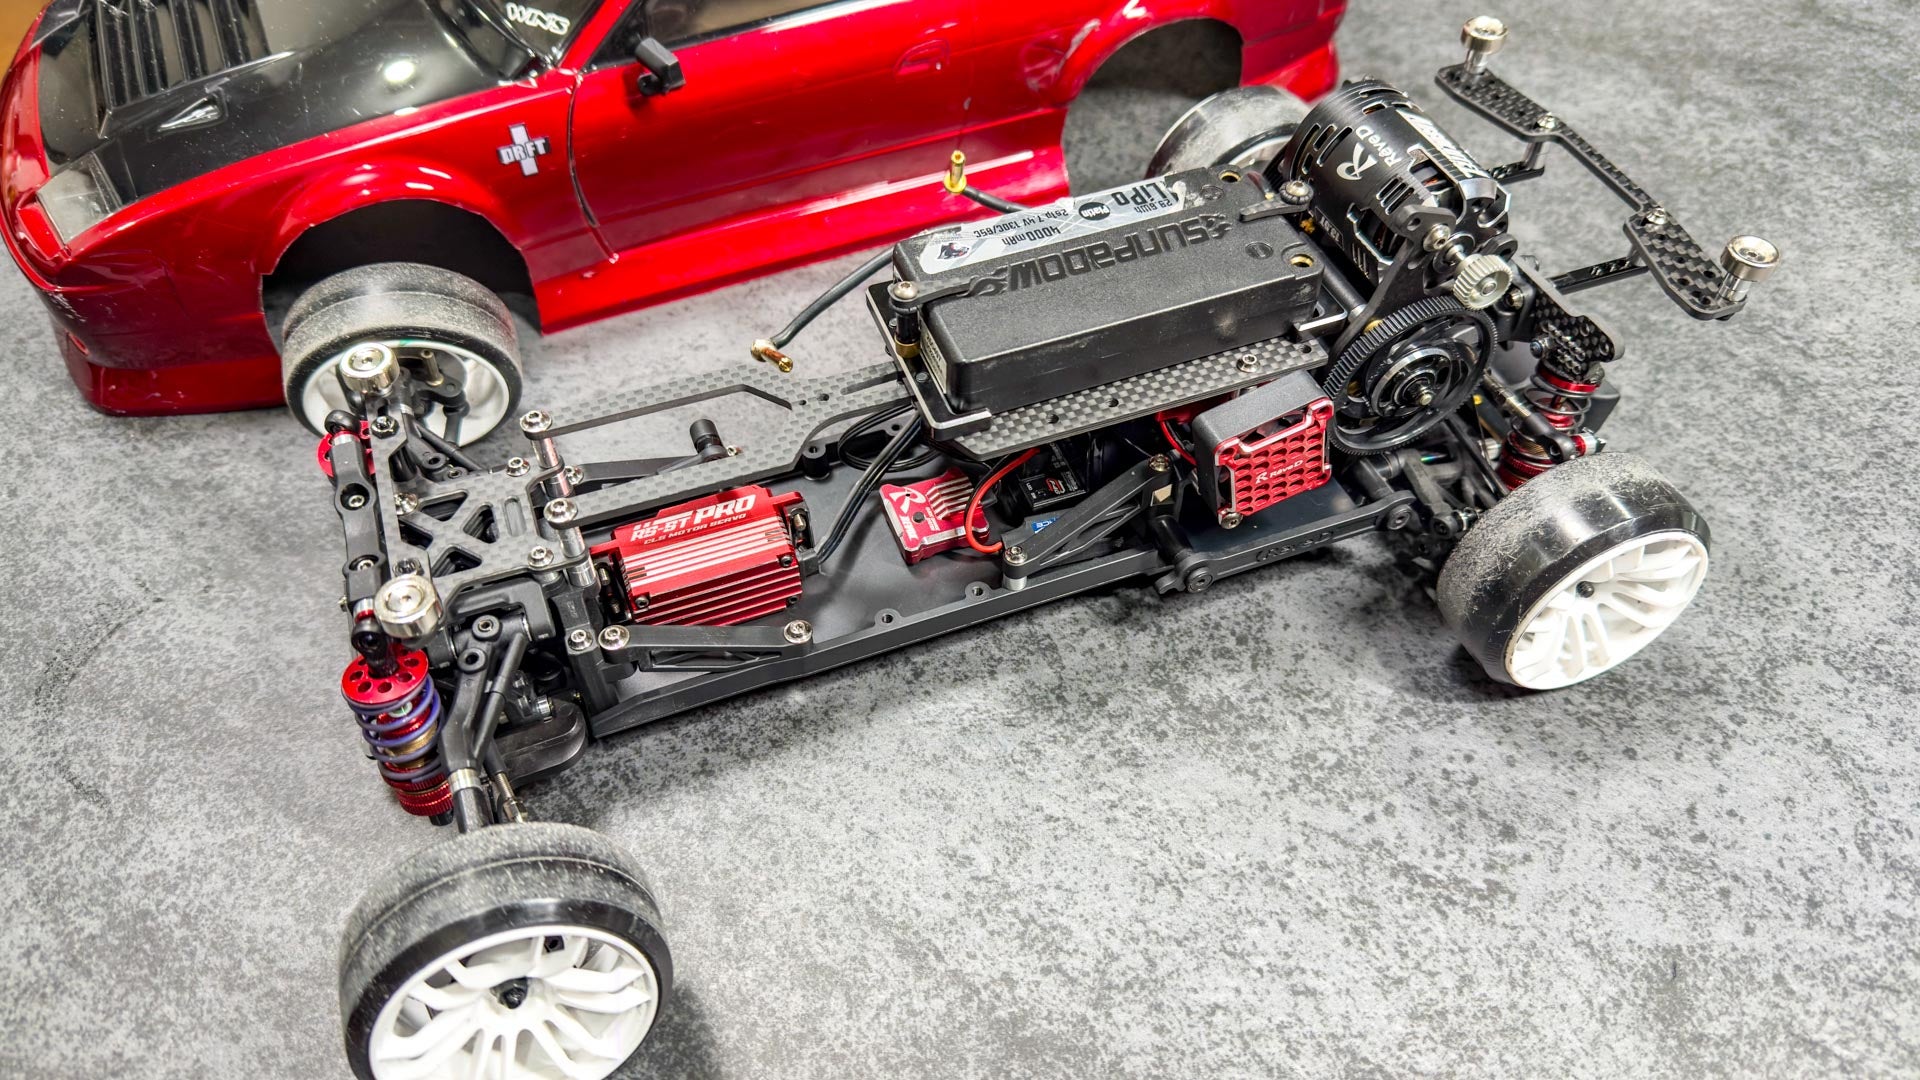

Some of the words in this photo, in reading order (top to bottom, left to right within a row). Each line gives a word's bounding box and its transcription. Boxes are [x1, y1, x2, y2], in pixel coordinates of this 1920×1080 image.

[1111, 182, 1168, 206] LiPo
[1022, 215, 1045, 227] 7.4V
[1081, 204, 1110, 218] Platin
[973, 222, 1022, 238] 130C/65C
[1001, 225, 1061, 246] 4000mAh
[631, 514, 693, 542] RS-ST
[693, 494, 756, 525] PRO
[669, 523, 708, 538] MOTOR
[709, 513, 747, 528] SERVO
